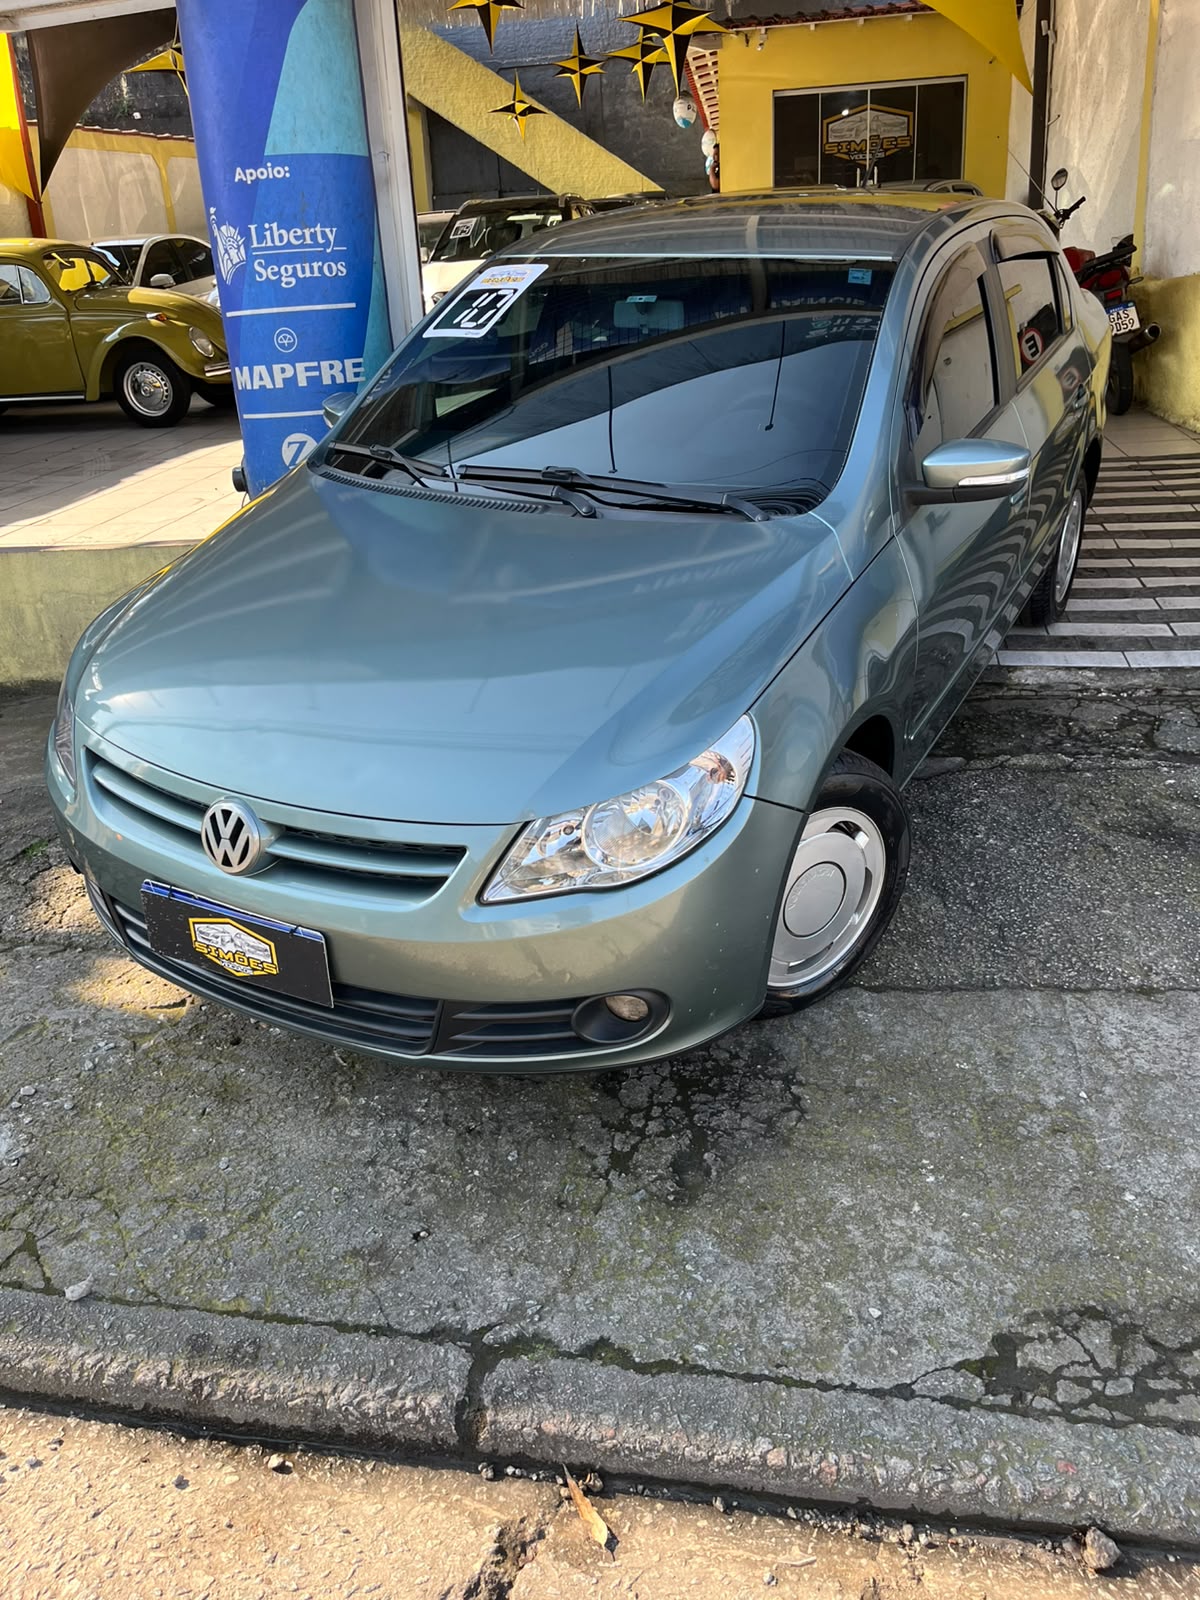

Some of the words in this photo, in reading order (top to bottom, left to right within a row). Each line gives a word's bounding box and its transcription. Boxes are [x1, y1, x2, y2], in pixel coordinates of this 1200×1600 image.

[824, 135, 911, 154] SIMÕES
[234, 162, 290, 184] Apoio:
[248, 222, 337, 253] Liberty
[254, 259, 347, 288] Seguros
[453, 289, 514, 328] 10
[1108, 309, 1130, 323] GAS
[234, 358, 366, 391] MAPFRE
[194, 941, 278, 975] SIMÕES
